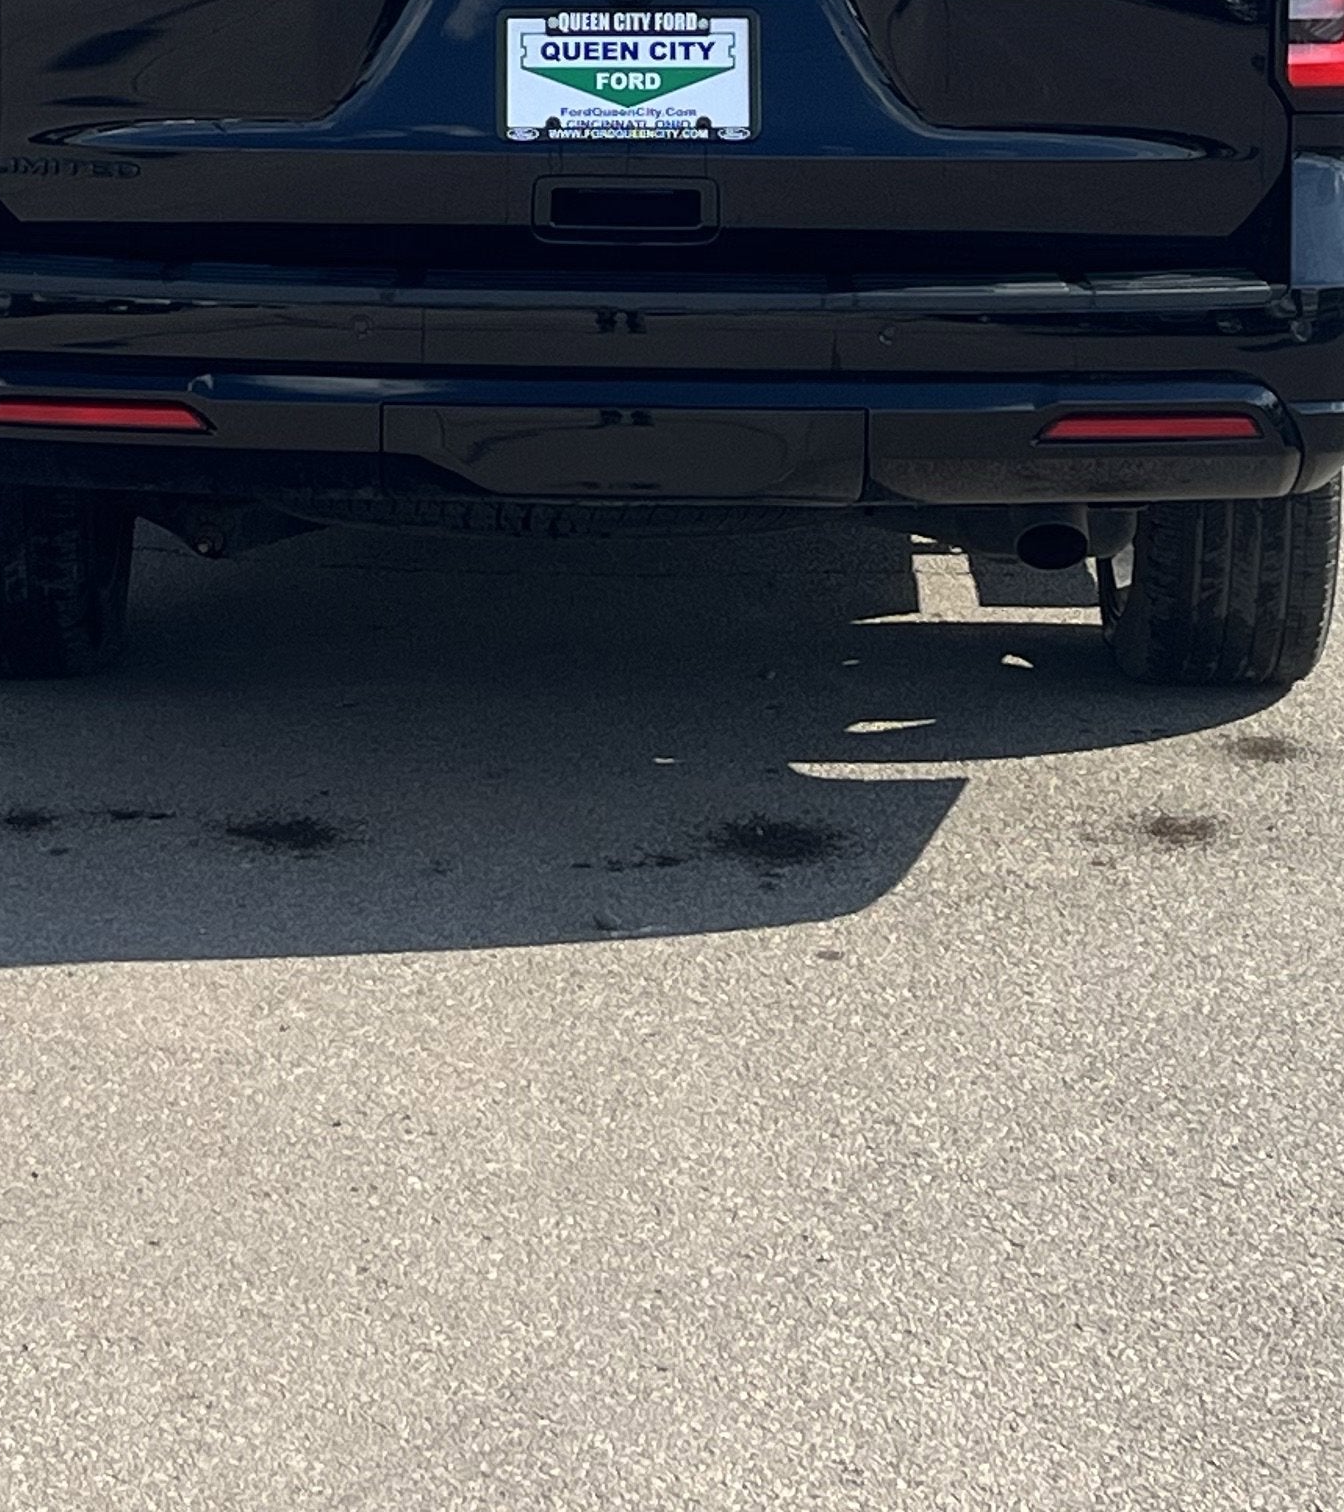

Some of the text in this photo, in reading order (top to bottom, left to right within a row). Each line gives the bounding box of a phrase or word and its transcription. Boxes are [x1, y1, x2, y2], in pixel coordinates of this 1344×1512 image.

[558, 12, 698, 32] QUEEN CITY FORD
[540, 41, 716, 61] QUEEN CITY
[595, 71, 662, 91] FORD
